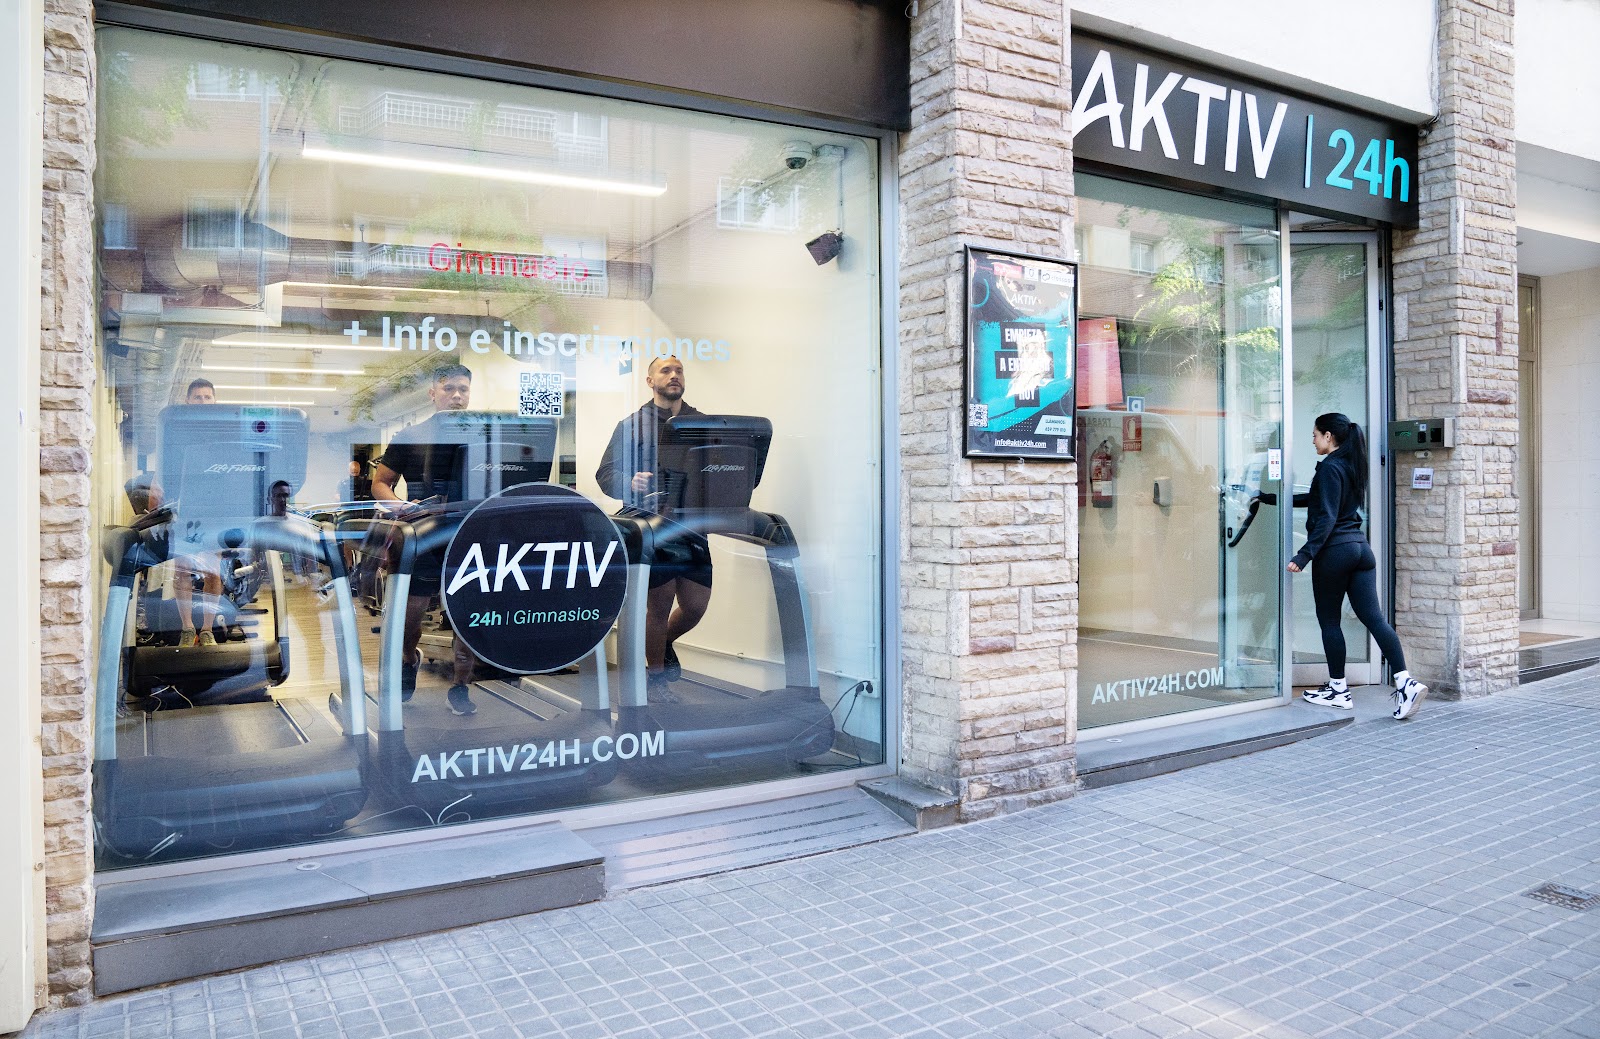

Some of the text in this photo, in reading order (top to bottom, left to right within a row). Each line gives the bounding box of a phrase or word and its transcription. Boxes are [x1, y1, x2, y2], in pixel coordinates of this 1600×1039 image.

[1072, 50, 1409, 203] AKTIV 24h
[429, 242, 588, 283] Gimnasio
[1011, 293, 1037, 306] AKTIV
[382, 316, 458, 352] Info
[470, 330, 491, 354] e
[503, 321, 731, 364] inscripciones
[447, 541, 618, 595] AKTIV
[469, 607, 600, 627] 24h Gimnasios
[1091, 666, 1224, 705] AKTIV24H.COM
[411, 730, 665, 783] AKTIV24H.COM
